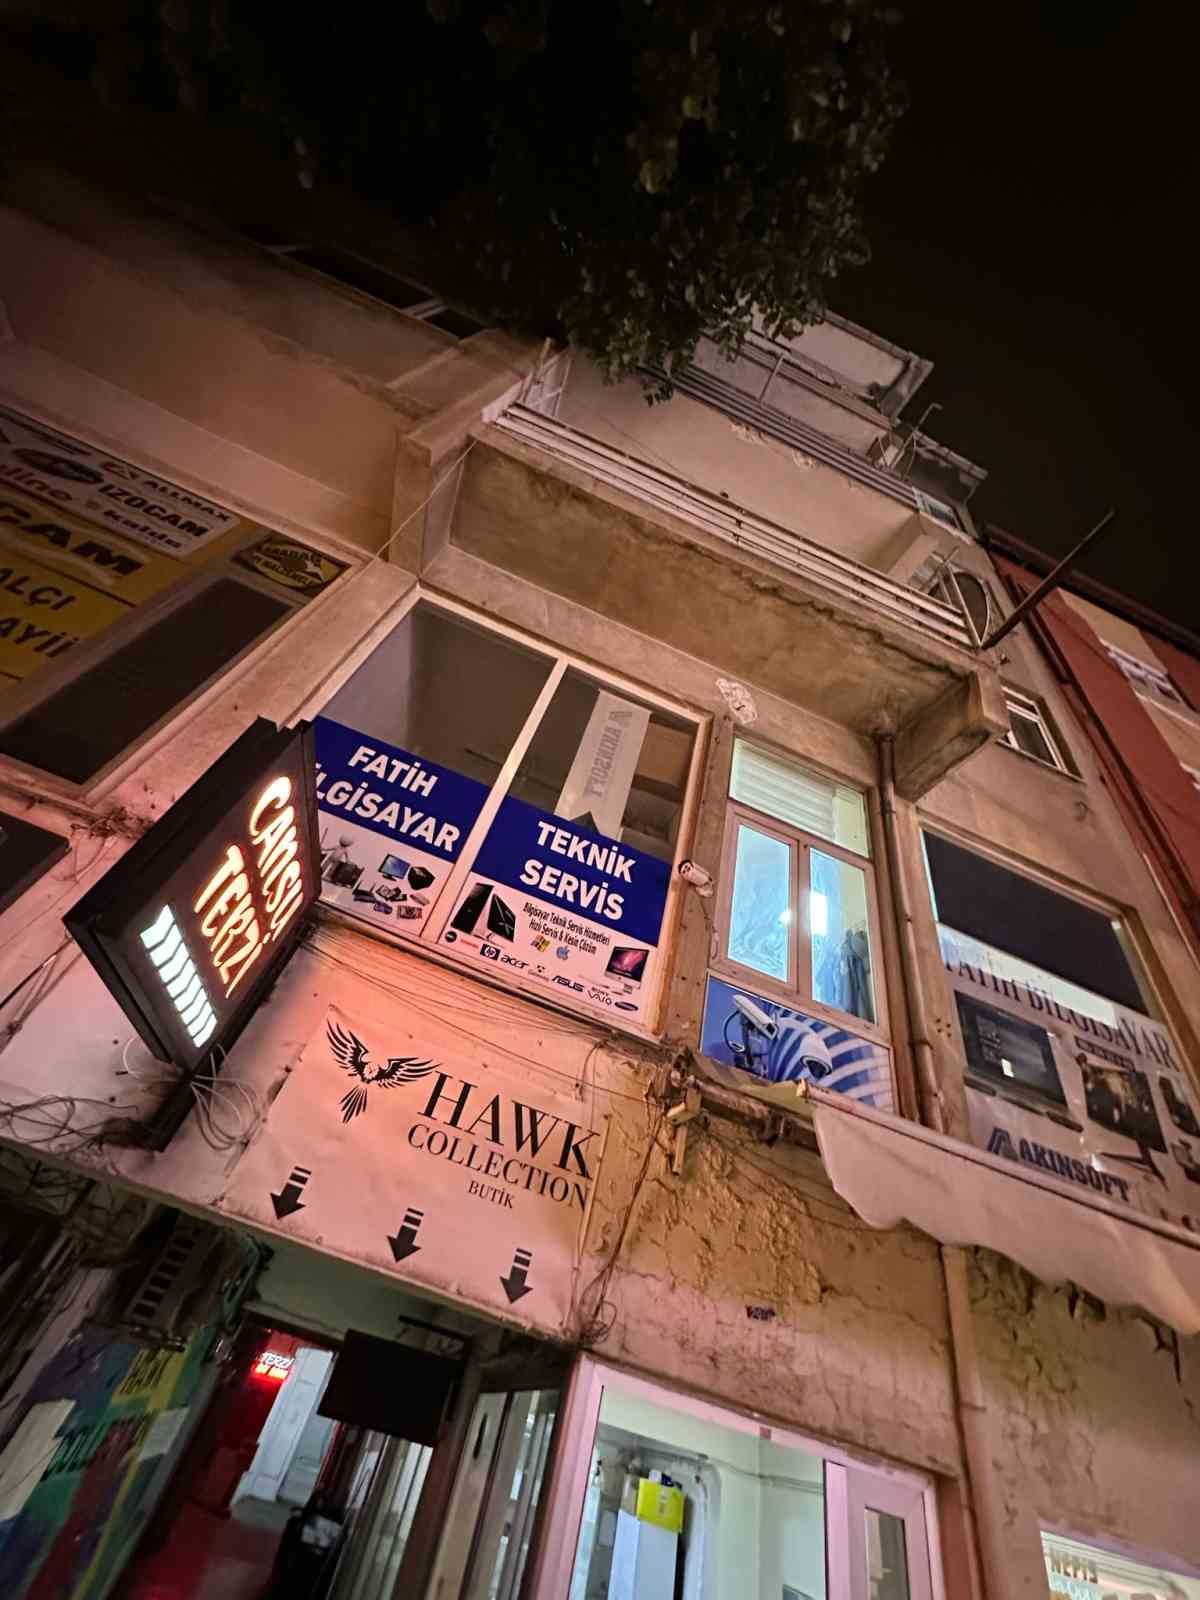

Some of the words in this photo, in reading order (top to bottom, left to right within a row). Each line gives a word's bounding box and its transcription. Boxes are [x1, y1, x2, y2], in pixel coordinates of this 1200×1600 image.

[348, 745, 438, 797] FATİH
[315, 762, 461, 852] LGİSAYAR
[249, 776, 303, 942] CANSU
[536, 821, 637, 883] TEKNİK
[519, 859, 625, 921] SERVİS
[417, 1071, 600, 1181] HAWK
[408, 1123, 592, 1212] COLLECTION
[468, 1180, 515, 1210] BUTİK
[1019, 1137, 1129, 1202] AKINSOFT
